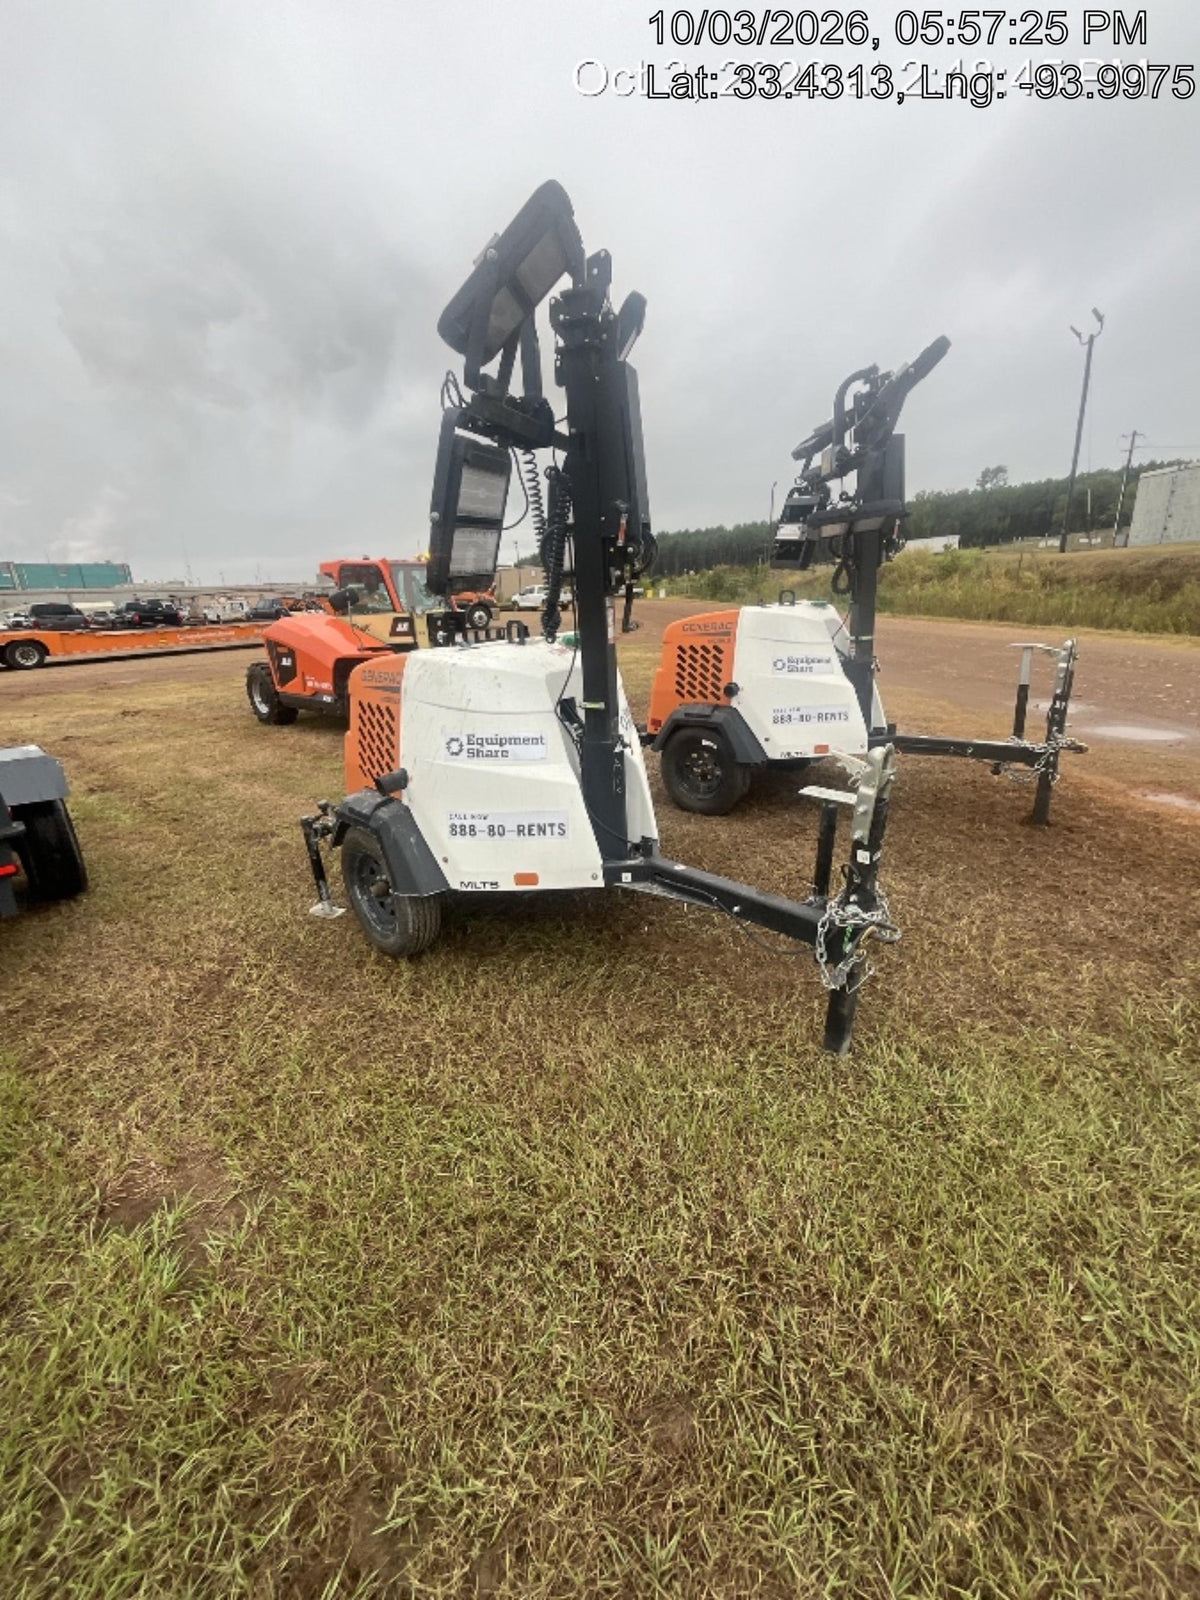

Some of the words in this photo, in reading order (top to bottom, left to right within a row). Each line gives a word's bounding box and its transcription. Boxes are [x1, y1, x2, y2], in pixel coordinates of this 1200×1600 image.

[466, 733, 546, 748] Equipment
[466, 748, 509, 758] Share
[449, 822, 566, 837] 888-80-RENTS
